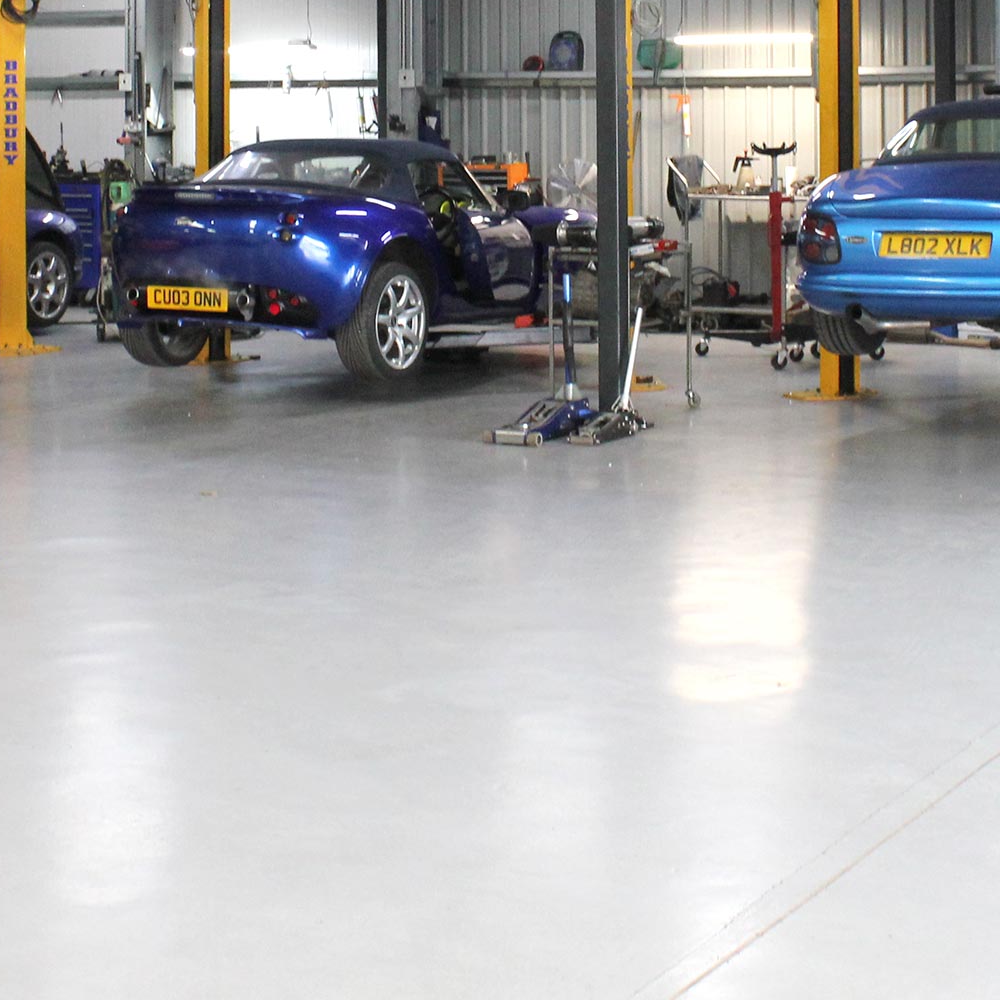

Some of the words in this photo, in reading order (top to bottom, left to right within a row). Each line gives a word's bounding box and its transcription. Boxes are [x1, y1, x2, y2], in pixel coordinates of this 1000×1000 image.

[4, 60, 18, 165] BRADBURY
[887, 237, 938, 255] L802
[943, 238, 983, 255] XLK
[153, 289, 190, 306] CU03
[194, 290, 222, 308] ONN
